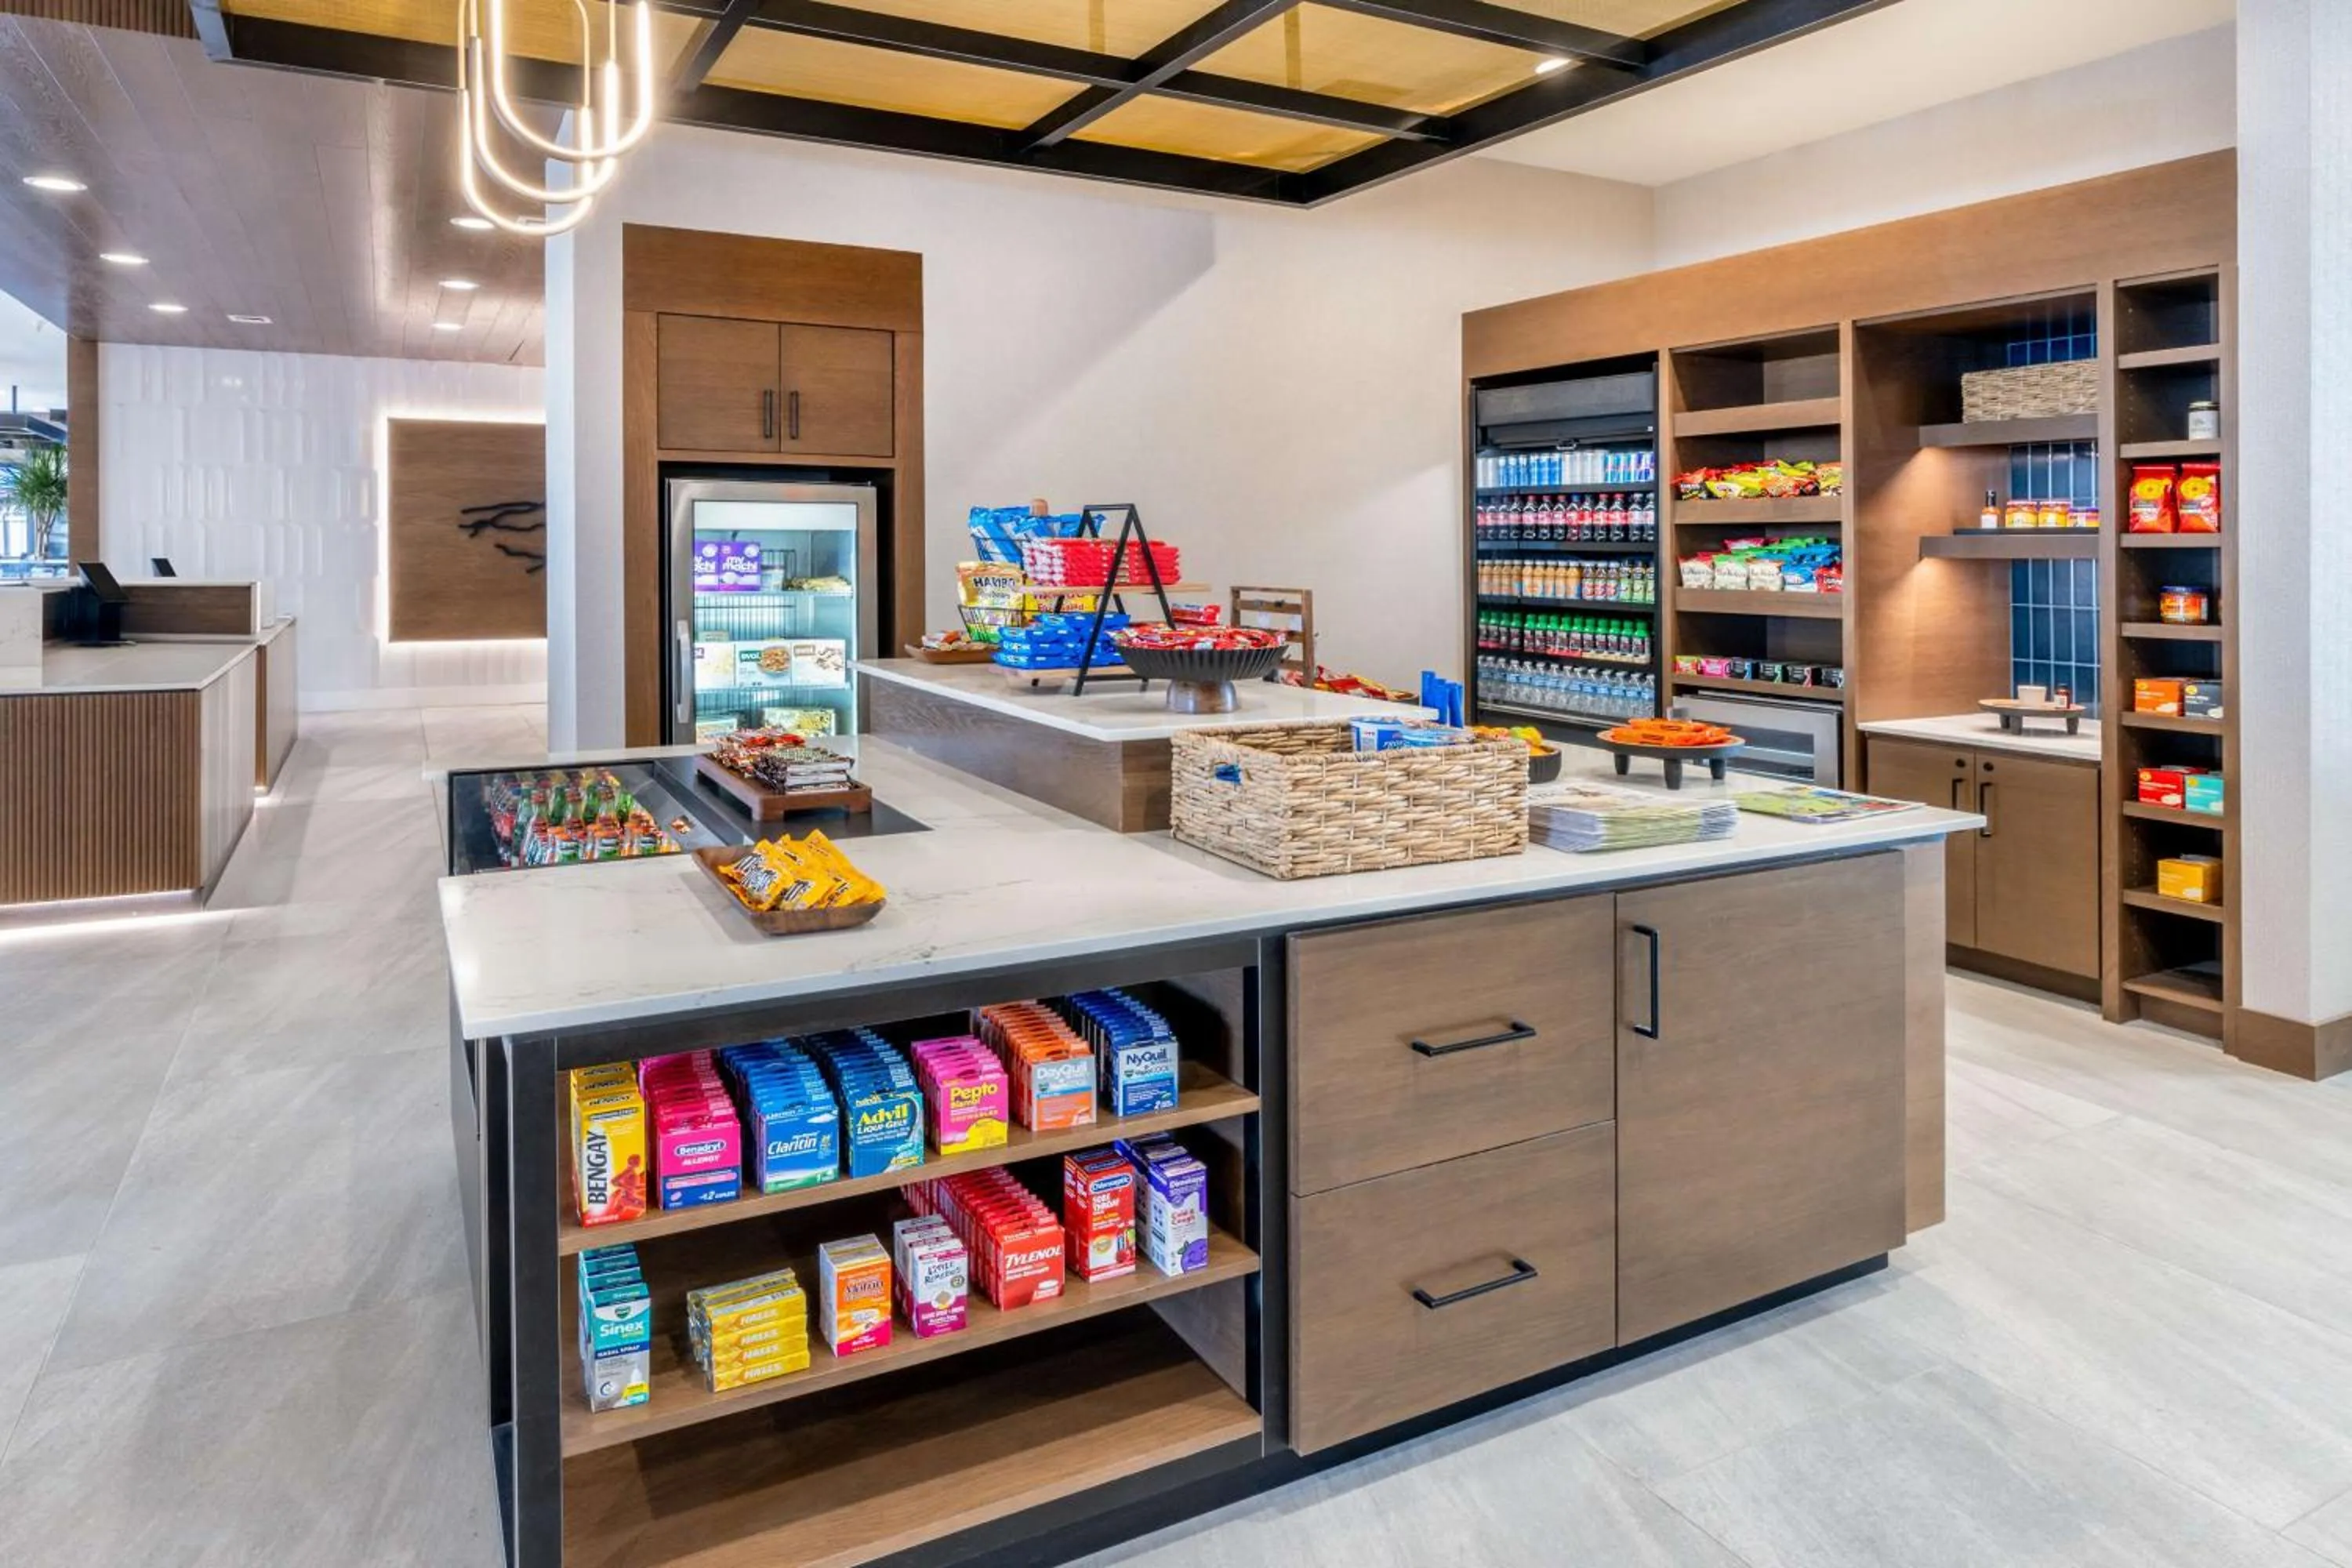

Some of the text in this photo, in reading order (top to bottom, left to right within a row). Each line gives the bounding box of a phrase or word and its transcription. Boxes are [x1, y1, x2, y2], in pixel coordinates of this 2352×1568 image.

[973, 576, 1016, 587] HARIBO
[1127, 1047, 1167, 1066] NyQuil
[1037, 1061, 1087, 1080] DayQuil
[950, 1083, 998, 1101] Pepto
[858, 1104, 908, 1124] Advil
[679, 1142, 720, 1155] Benadryl
[768, 1136, 817, 1156] Claritin
[587, 1131, 608, 1204] BENGAY
[681, 1155, 720, 1166] ALLERGY
[1005, 1246, 1062, 1269] TYLENOL
[740, 1308, 779, 1326] HALLS
[600, 1321, 644, 1338] Sinex
